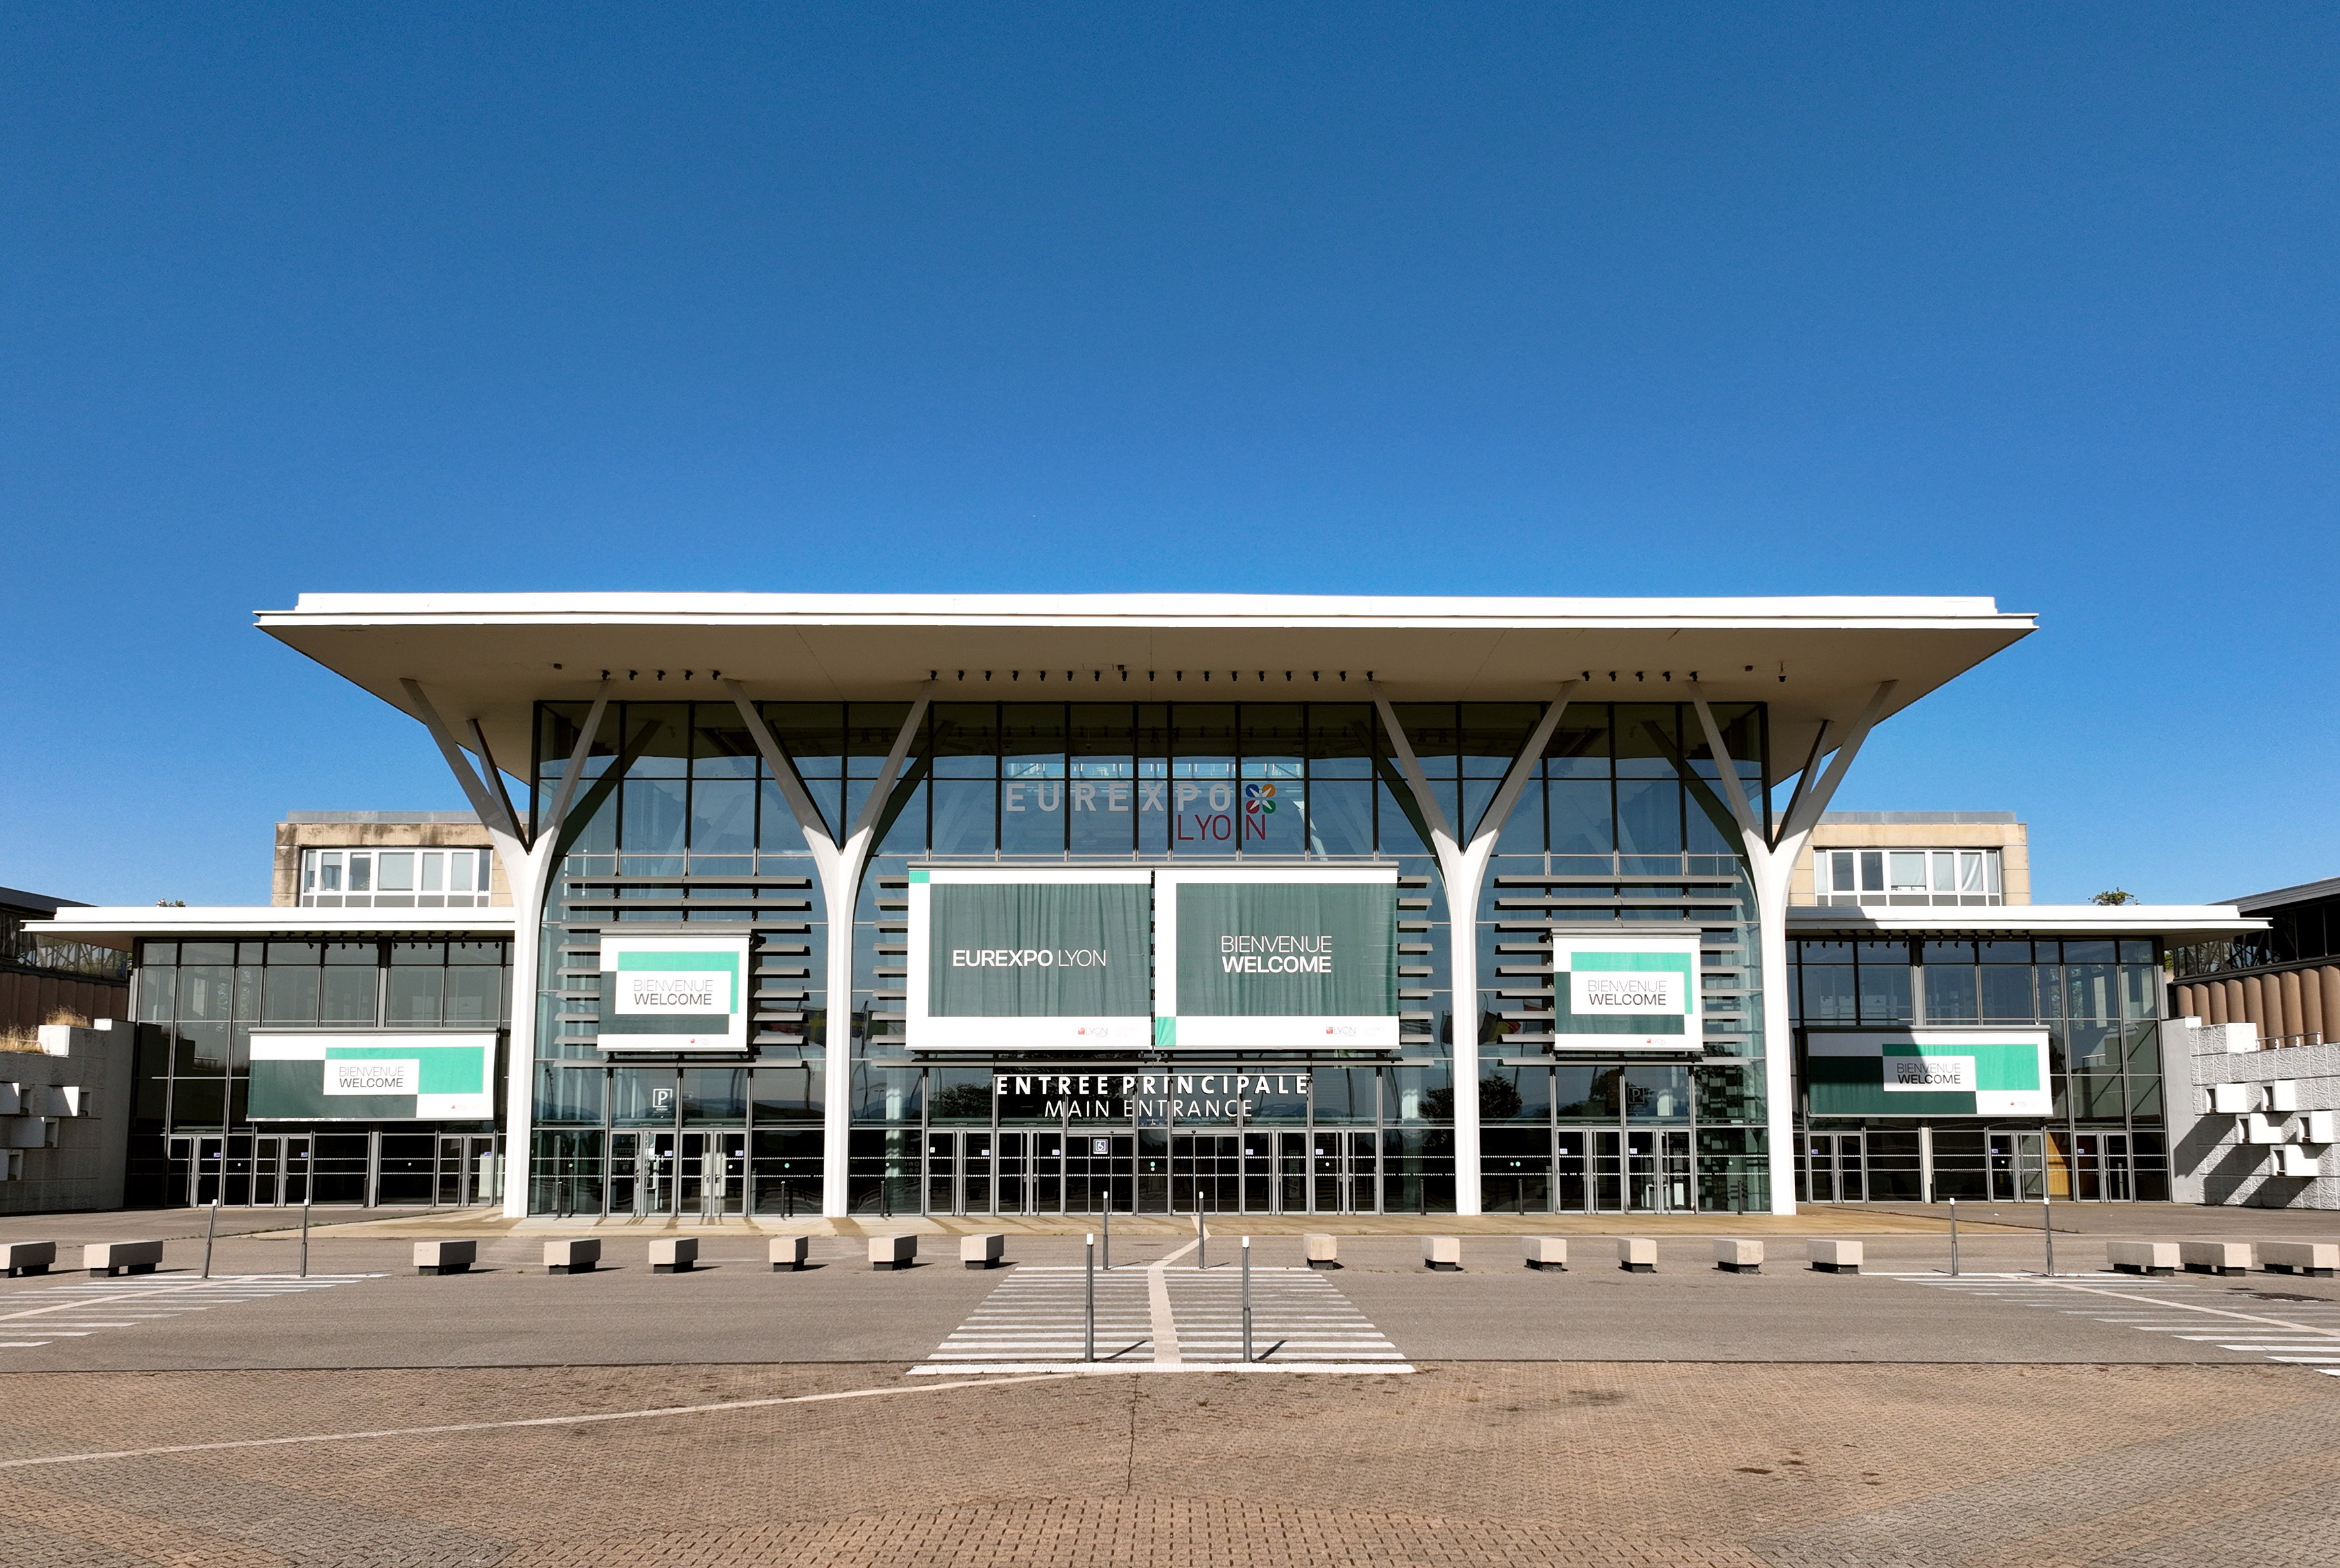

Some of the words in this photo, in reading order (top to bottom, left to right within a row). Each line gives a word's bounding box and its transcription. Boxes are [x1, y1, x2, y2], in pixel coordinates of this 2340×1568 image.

[1005, 783, 1231, 812] EUREXPO
[1178, 814, 1266, 841] LYON
[1221, 935, 1332, 953] BIENVENUE
[952, 949, 1053, 967] EUREXPO
[1058, 949, 1106, 967] LYON
[1222, 956, 1331, 974] WELCOME
[633, 979, 714, 992] BIENVENUE
[1588, 980, 1666, 993] BIENVENUE
[633, 993, 712, 1005] WELCOME
[1588, 993, 1666, 1006] WELCOME
[339, 1066, 404, 1077] BIENVENUE
[1896, 1062, 1961, 1073] BIENVENUE
[339, 1077, 404, 1088] WELCOME
[997, 1075, 1108, 1095] ENTREE
[1122, 1075, 1308, 1095] PRINCIPALE
[1897, 1074, 1961, 1085] WELCOME
[658, 1090, 668, 1106] P
[1632, 1088, 1641, 1102] P
[1044, 1100, 1109, 1118] MAIN
[1123, 1100, 1253, 1118] ENTRANCE
